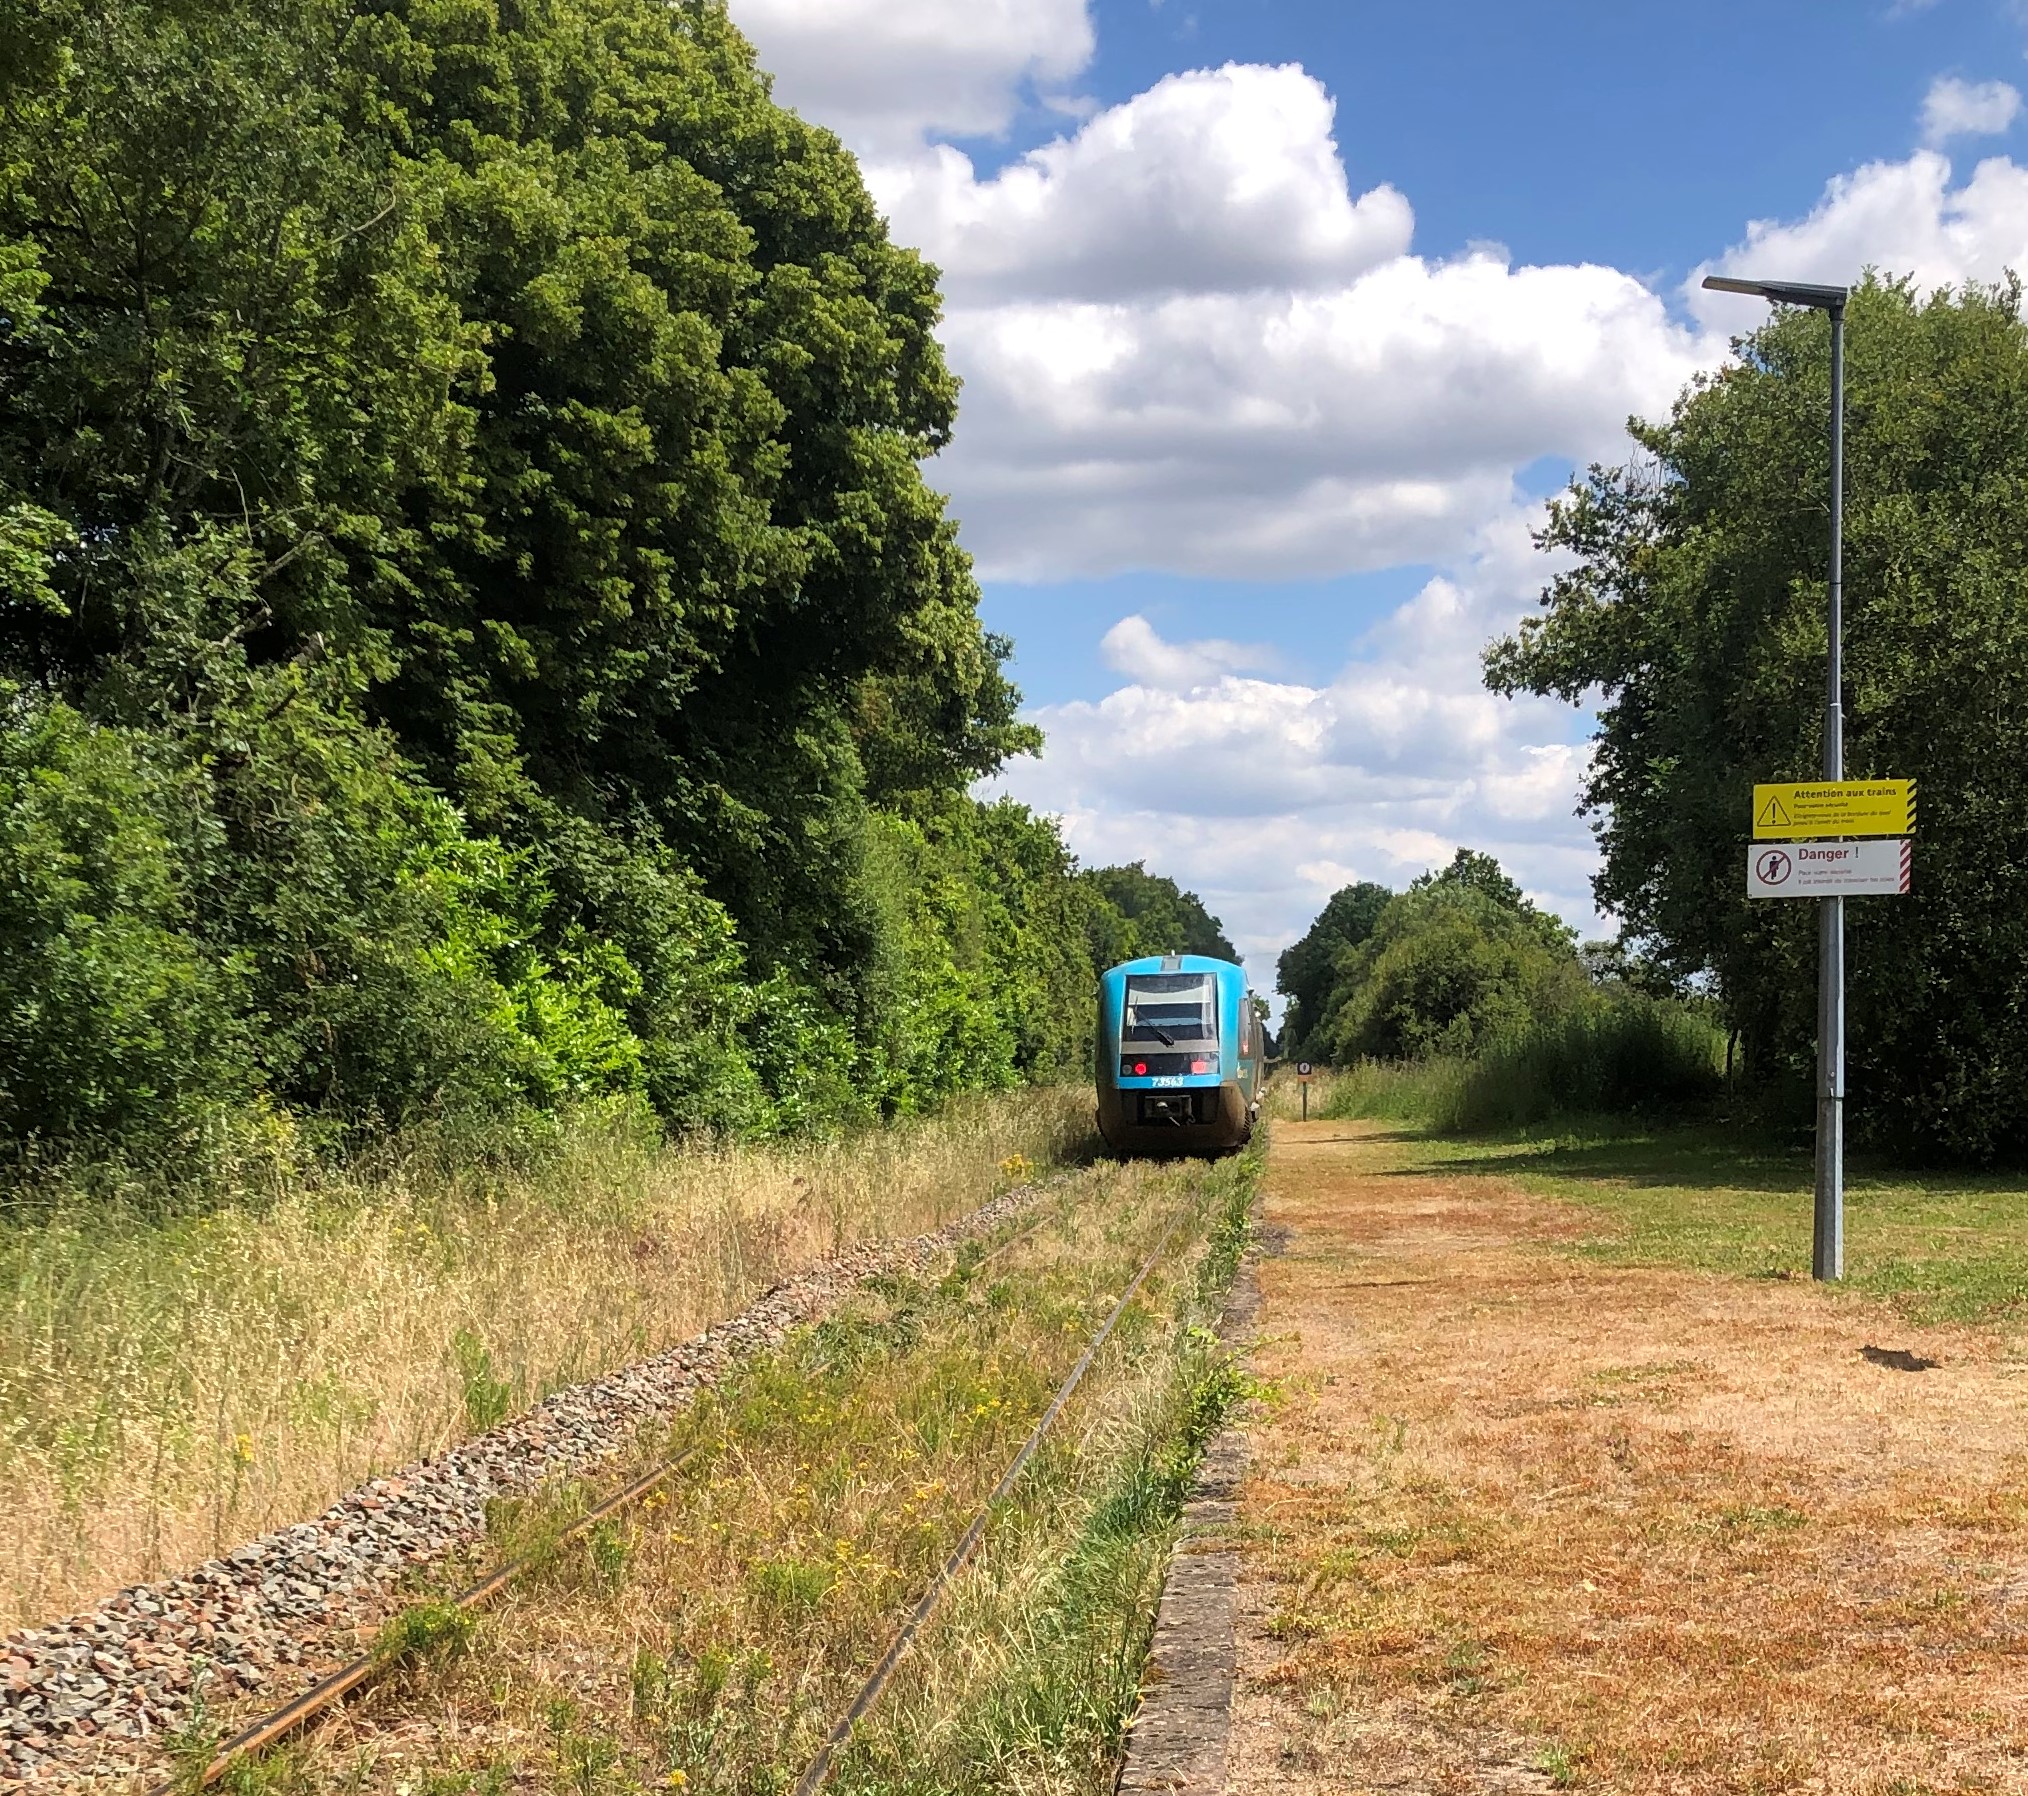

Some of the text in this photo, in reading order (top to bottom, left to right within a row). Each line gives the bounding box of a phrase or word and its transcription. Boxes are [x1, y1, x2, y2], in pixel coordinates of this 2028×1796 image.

[1794, 787, 1897, 799] Attention aux trains
[1798, 846, 1859, 862] Danger !
